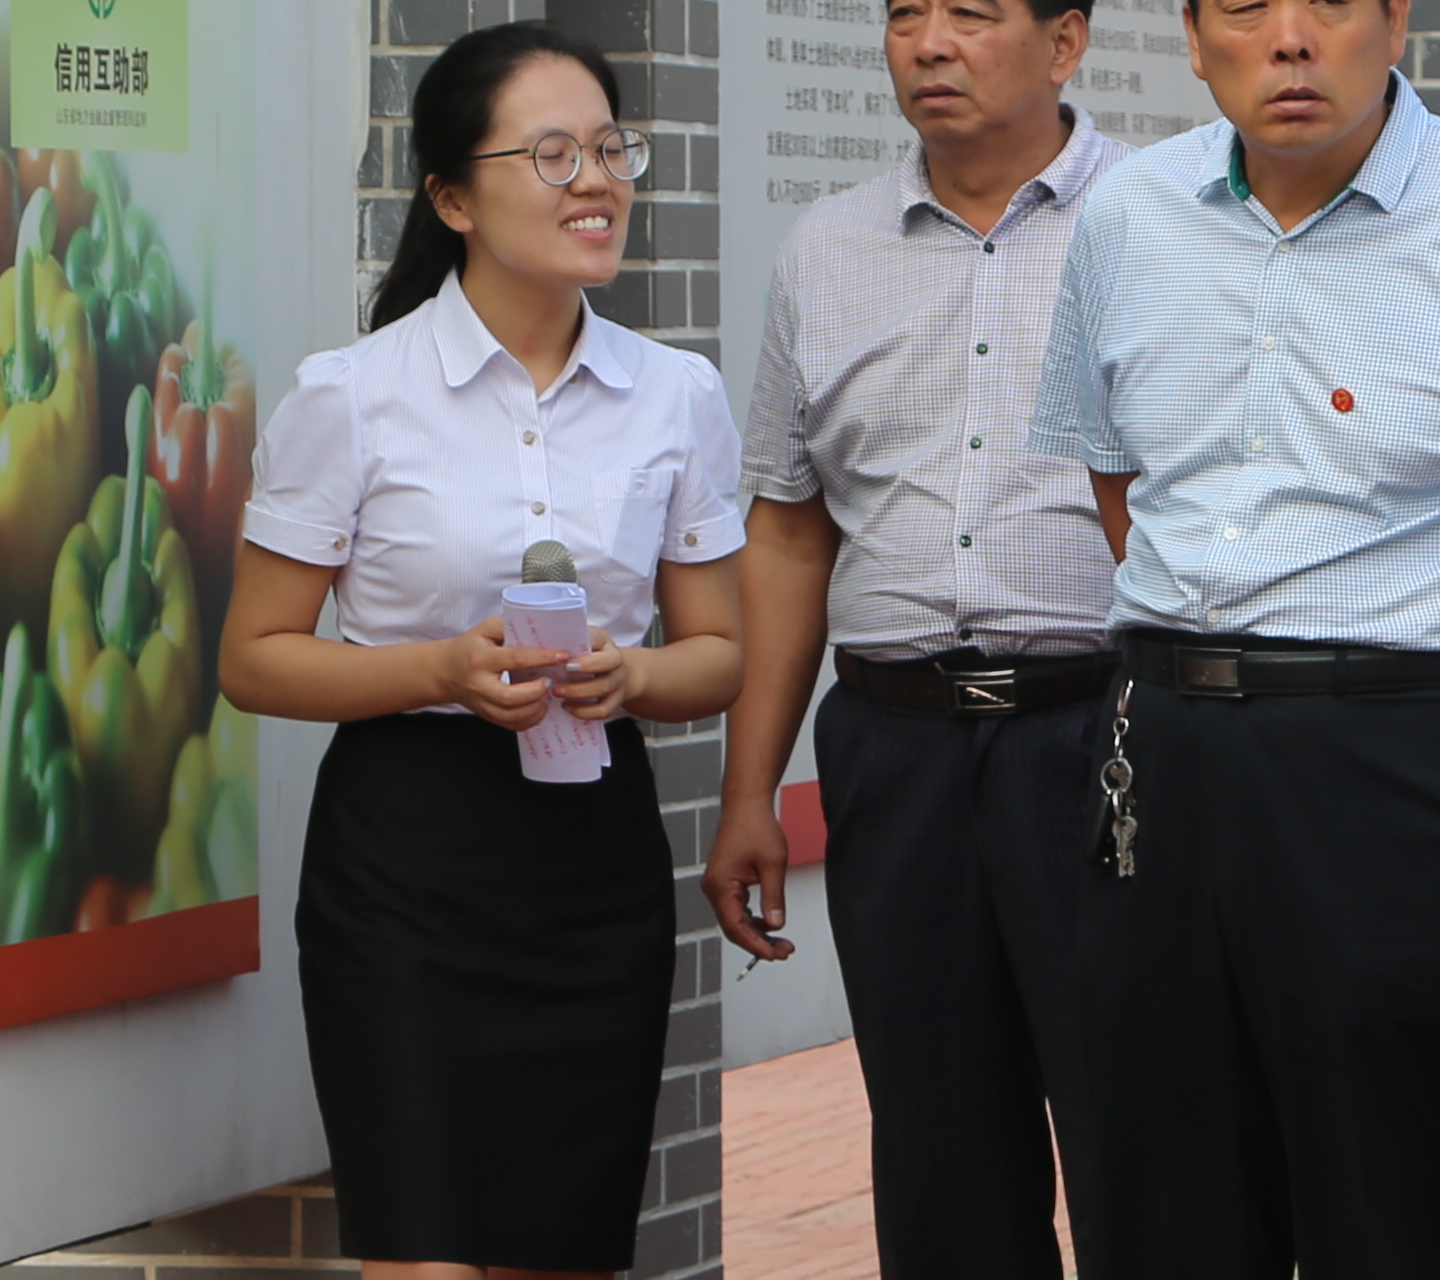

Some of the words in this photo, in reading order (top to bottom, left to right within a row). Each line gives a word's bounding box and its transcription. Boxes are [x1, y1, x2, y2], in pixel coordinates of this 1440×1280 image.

[54, 42, 149, 97] 信用互助部
